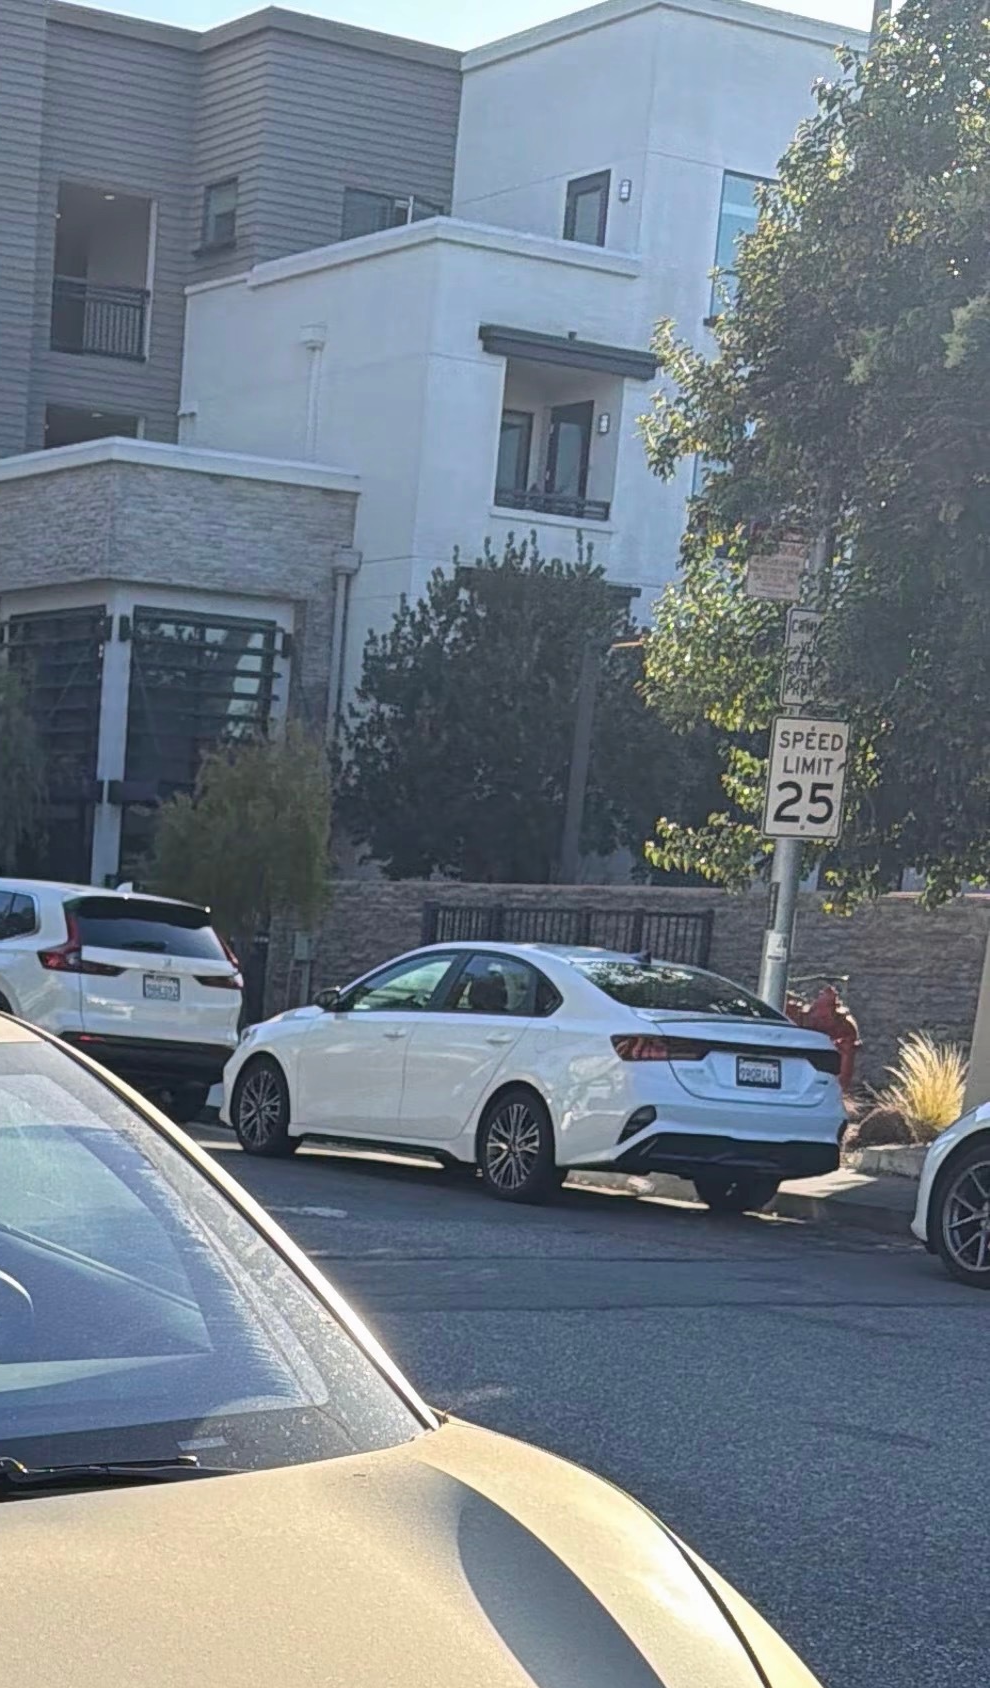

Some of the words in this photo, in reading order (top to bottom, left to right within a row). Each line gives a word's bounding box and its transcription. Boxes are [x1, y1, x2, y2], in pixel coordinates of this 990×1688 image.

[778, 730, 844, 752] SPEED
[782, 755, 834, 776] LIMIT
[772, 780, 834, 824] 25
